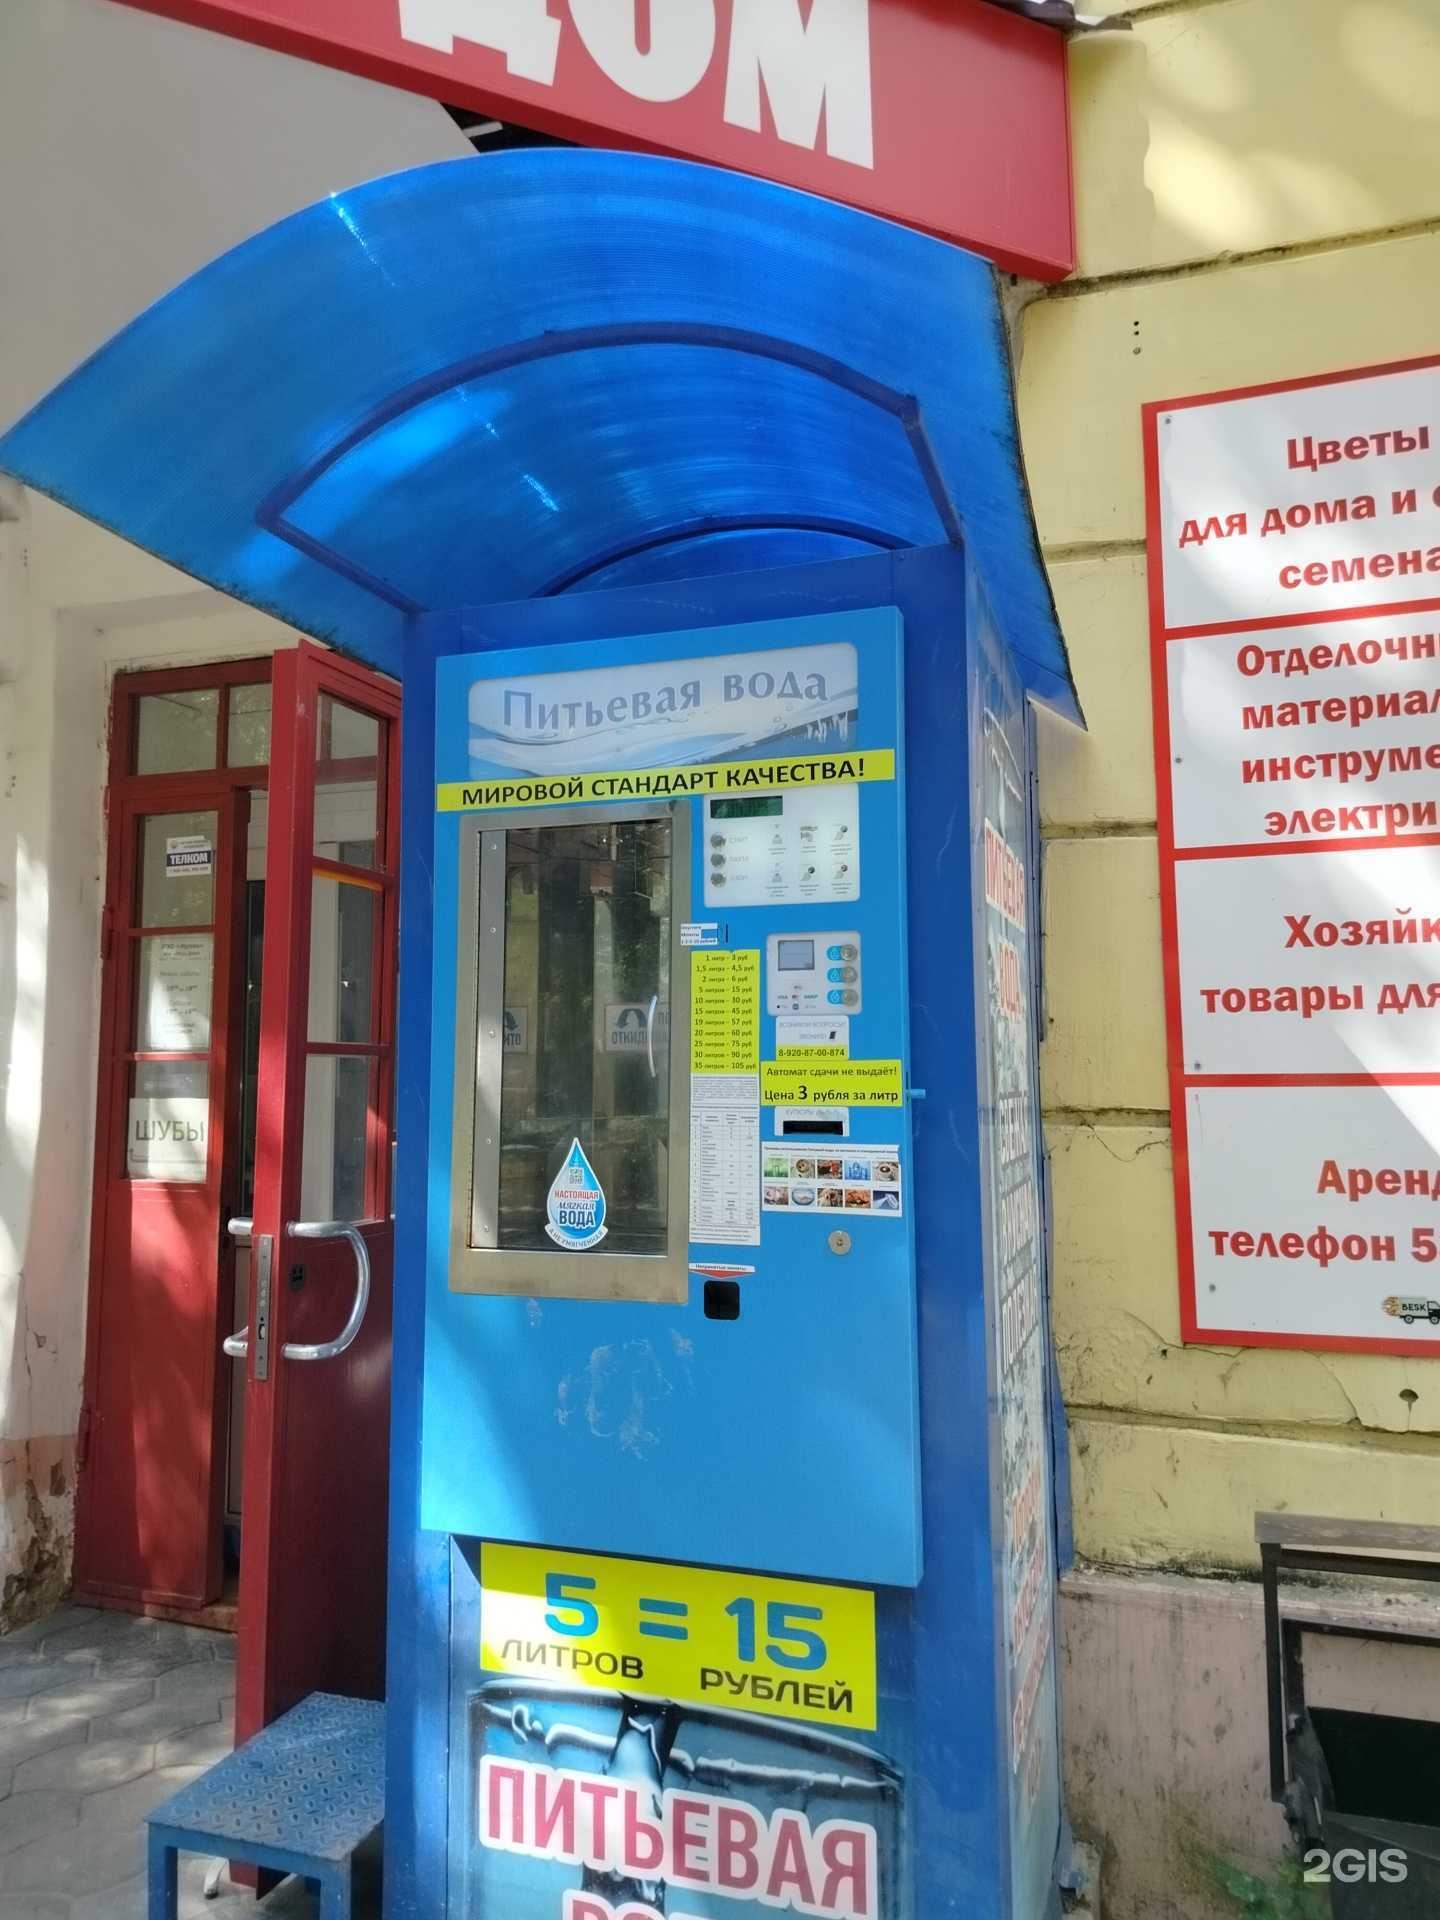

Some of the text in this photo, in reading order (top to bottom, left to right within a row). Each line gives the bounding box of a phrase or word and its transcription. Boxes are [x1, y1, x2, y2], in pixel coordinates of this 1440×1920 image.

[1286, 426, 1430, 472] Цветы
[1178, 512, 1248, 548] для
[1260, 494, 1376, 537] дома
[1391, 488, 1417, 515] и
[1278, 546, 1440, 589] семена
[1237, 633, 1440, 677] Отделочн
[503, 671, 828, 733] Питьевая вода
[461, 757, 866, 805] МИРОВОЙ СТАНДАРТ КАЧЕСТВА!
[1242, 741, 1440, 784] инструме
[1264, 801, 1438, 836] электри
[169, 852, 208, 865] ТЕЛКОМ
[1283, 907, 1440, 949] Хозяйк
[1200, 984, 1364, 1018] товары
[766, 1067, 807, 1076] Автомат
[809, 1068, 839, 1077] сдачи
[856, 1066, 897, 1077] выдаёт!
[764, 1085, 898, 1102] Цена 3 рубля за литр
[136, 1120, 204, 1141] ШУБЫ
[554, 1189, 599, 1200] НАСТОЯЩАЯ
[559, 1210, 594, 1227] ВОДА
[1208, 1226, 1440, 1267] телефон 5
[544, 1572, 599, 1637] 5
[724, 1596, 828, 1671] 15
[500, 1639, 853, 1714] ЛИТРОВ РУБЛЕЙ
[487, 1764, 867, 1916] ПИТЬЕВАЯ
